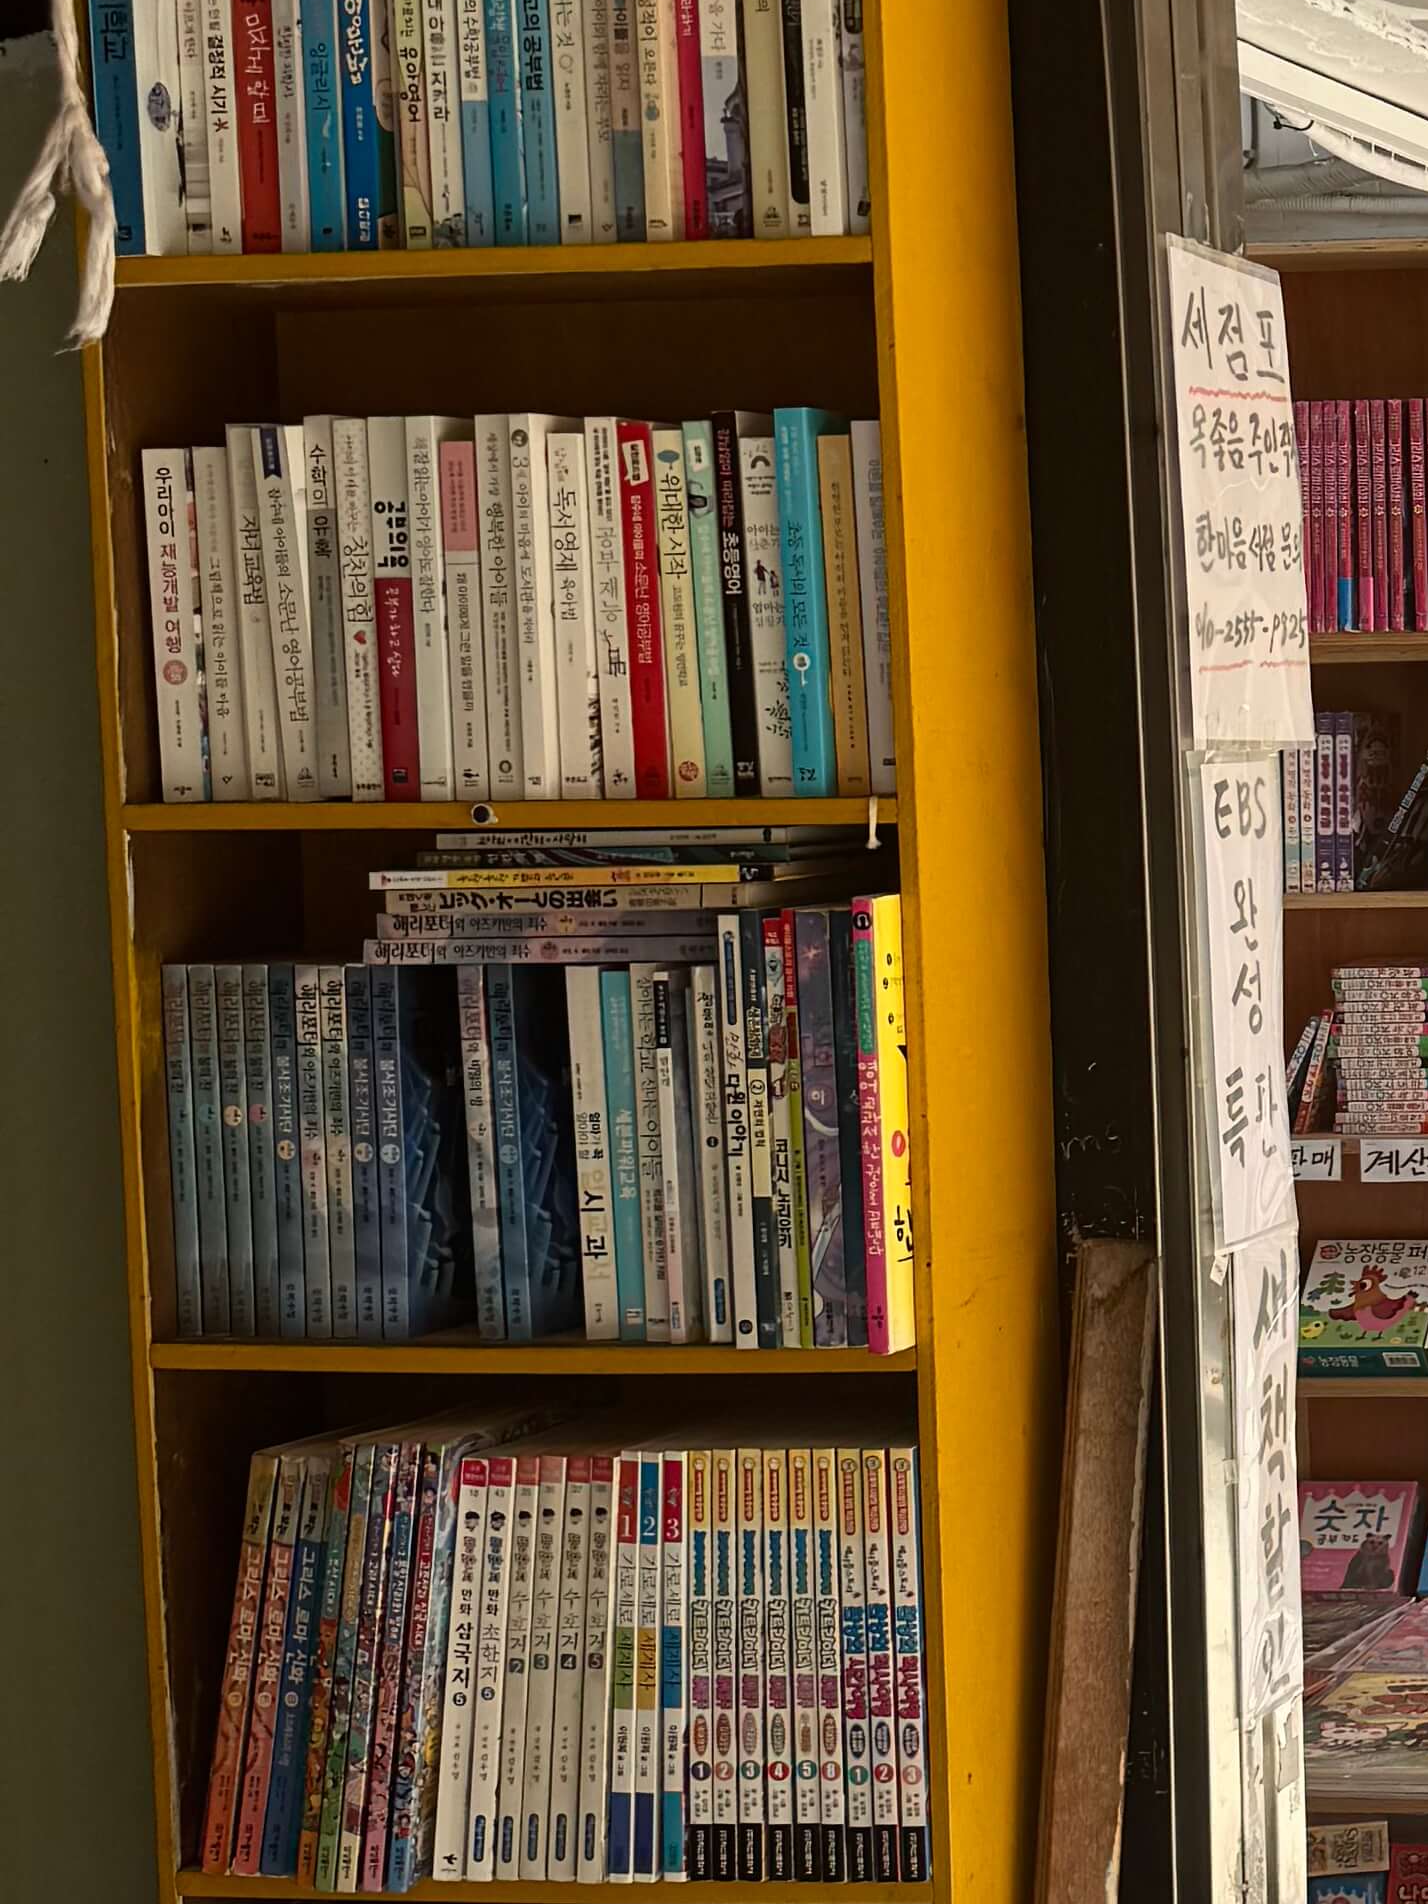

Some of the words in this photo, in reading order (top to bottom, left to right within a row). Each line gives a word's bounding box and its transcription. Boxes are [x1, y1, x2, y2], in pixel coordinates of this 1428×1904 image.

[207, 34, 227, 80] 결정적
[244, 14, 271, 74] 미치게
[462, 15, 481, 80] 수학공부법
[524, 34, 545, 91] 공부법
[554, 32, 575, 49] 것
[709, 21, 727, 51] 가다
[246, 78, 270, 97] 할
[309, 42, 332, 112] 잉글리시
[400, 46, 422, 123] 유아영어
[643, 46, 658, 86] 오른다
[209, 84, 228, 115] 시기
[251, 101, 271, 125] 때
[486, 501, 506, 551] 행복한
[552, 485, 580, 572] 독서영재
[658, 471, 684, 534] 위대한
[239, 514, 264, 605] 자녀교육법
[343, 535, 371, 599] 칭찬의
[665, 535, 688, 580] 시작
[722, 530, 743, 596] 초등영어
[1196, 511, 1248, 574] 한마음
[278, 581, 296, 635] 소문난
[488, 555, 508, 607] 아이들
[347, 603, 374, 623] 힘
[283, 637, 310, 723] 영어공부법
[1213, 777, 1270, 841] EBS
[379, 1058, 398, 1138] 불사조기사단
[724, 1072, 747, 1105] 다윈
[726, 1108, 748, 1158] 이야기
[1340, 1240, 1407, 1267] 농장동물
[666, 1517, 681, 1539] 3
[1312, 1498, 1391, 1533] 숫자
[297, 1546, 316, 1601] 그리스
[294, 1606, 312, 1644] 로마
[560, 1589, 582, 1651] 수호지
[285, 1648, 309, 1686] 신화
[450, 1620, 476, 1691] 삼국지
[478, 1622, 502, 1684] 초한지
